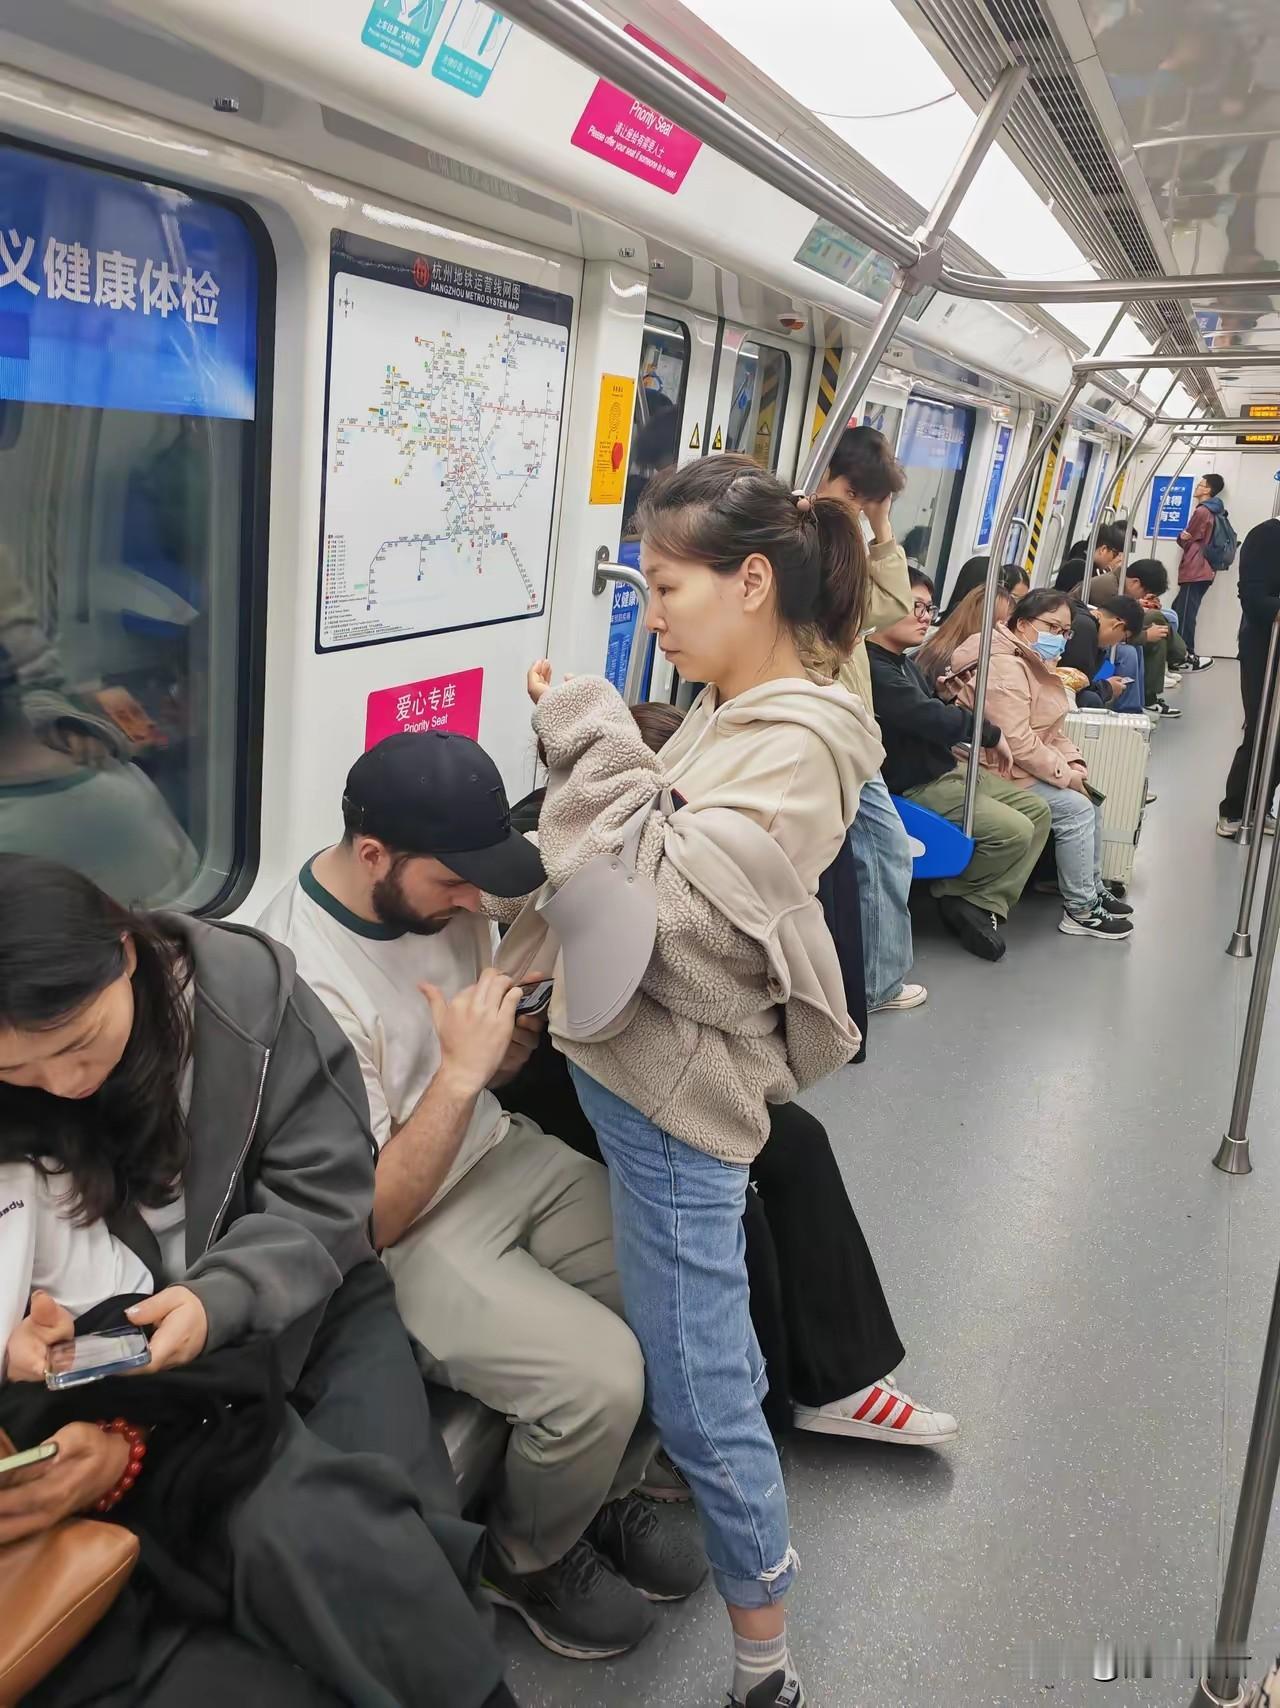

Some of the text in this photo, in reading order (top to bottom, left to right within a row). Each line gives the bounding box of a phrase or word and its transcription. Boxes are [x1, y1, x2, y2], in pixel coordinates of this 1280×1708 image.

[0, 228, 220, 325] 义健康体检
[432, 261, 520, 302] 杭州地铁运营线网图
[430, 281, 520, 311] HANGZHOU METRO SYSTEM MAP
[613, 590, 639, 609] 义健康
[395, 683, 457, 721] 爱心专座
[404, 713, 448, 733] Priority Seat
